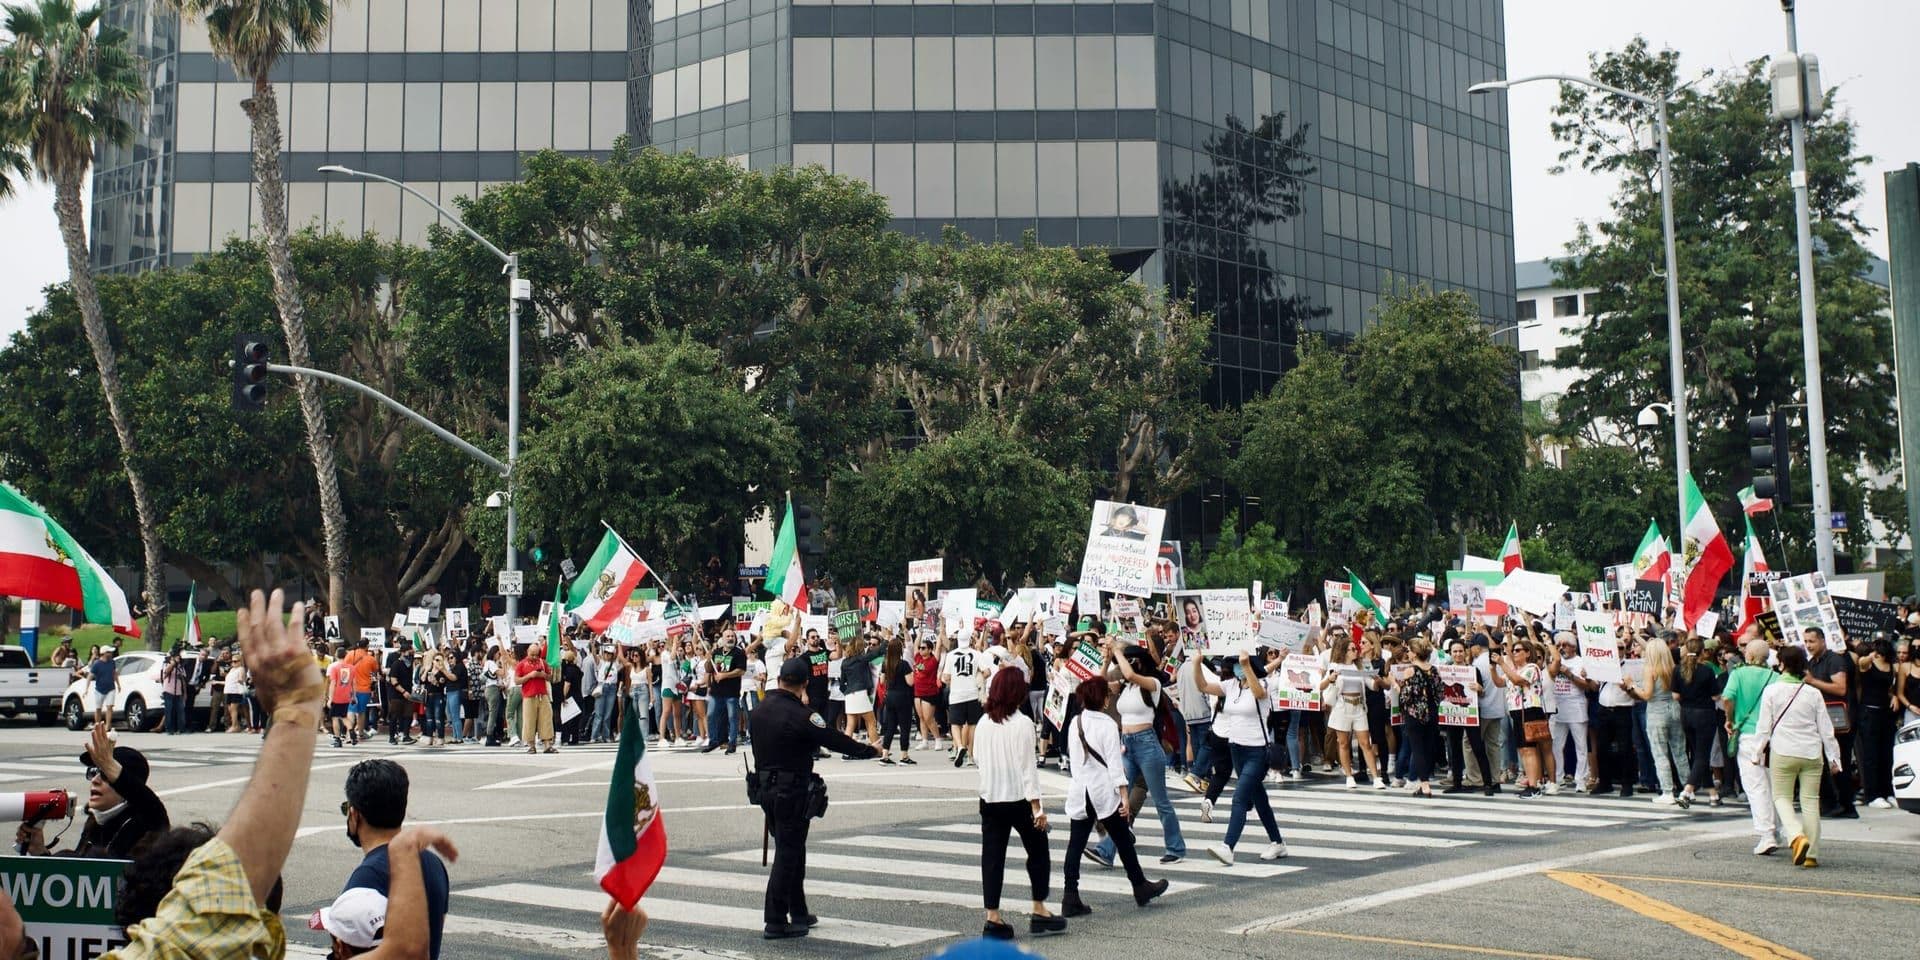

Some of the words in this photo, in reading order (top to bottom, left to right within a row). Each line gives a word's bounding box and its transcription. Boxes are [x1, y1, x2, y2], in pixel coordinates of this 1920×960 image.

[739, 567, 763, 576] Wilshire
[1627, 600, 1657, 613] AMINI
[953, 651, 974, 677] B
[1079, 656, 1096, 671] LIFE
